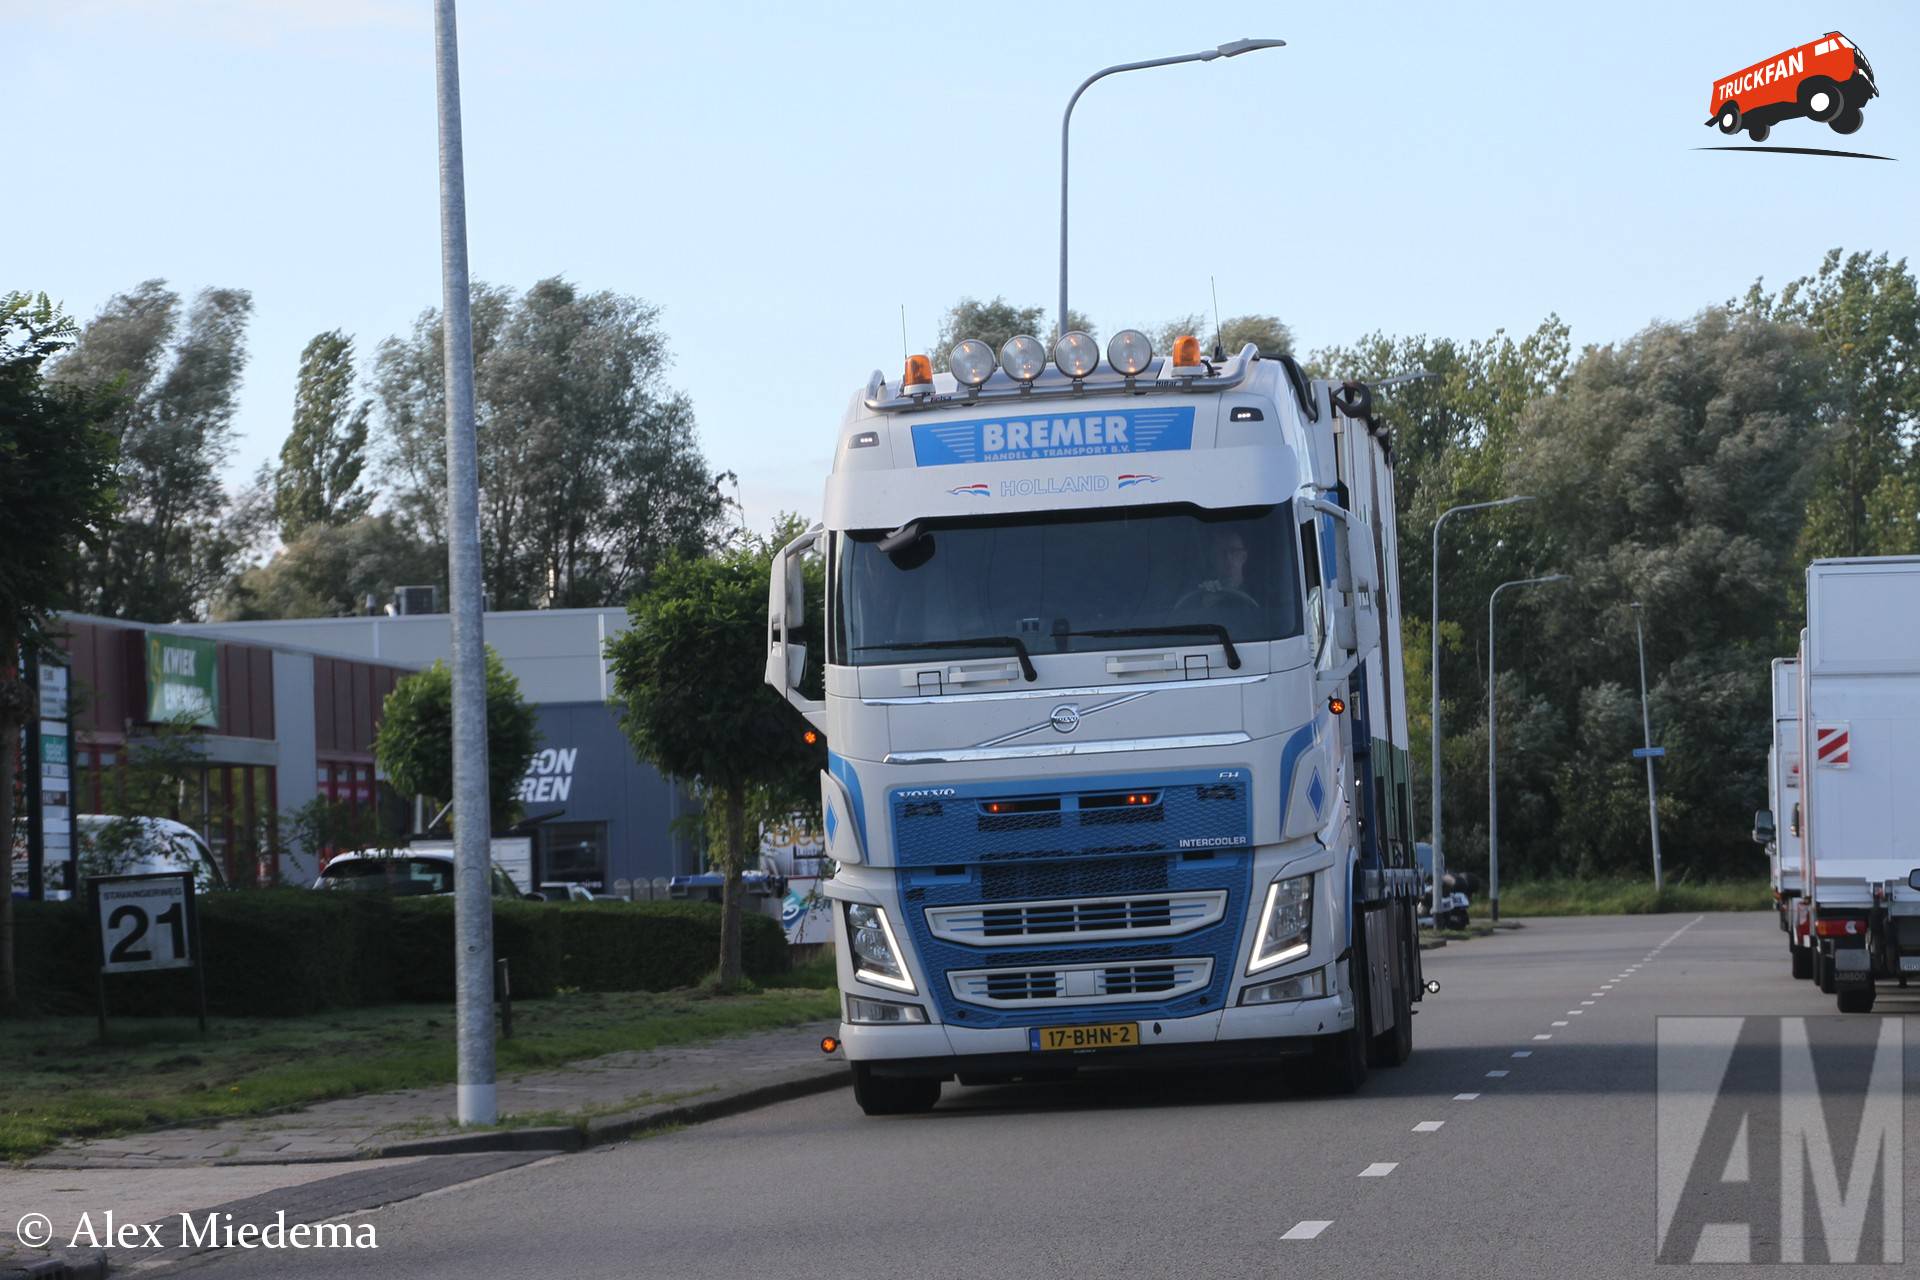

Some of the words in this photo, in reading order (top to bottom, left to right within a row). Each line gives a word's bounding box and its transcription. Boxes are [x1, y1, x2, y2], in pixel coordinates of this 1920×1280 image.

[983, 416, 1128, 451] BREMER
[984, 451, 1028, 462] HANDEL
[1031, 449, 1040, 458] &
[1044, 446, 1107, 457] TRANSPORT
[1111, 445, 1131, 453] B.V.
[1001, 475, 1109, 497] HOLLAND
[897, 788, 955, 800] VOLVO
[1179, 836, 1247, 848] INTERCOOLER
[107, 902, 186, 963] 21
[1048, 1027, 1131, 1047] 17-BHN-2
